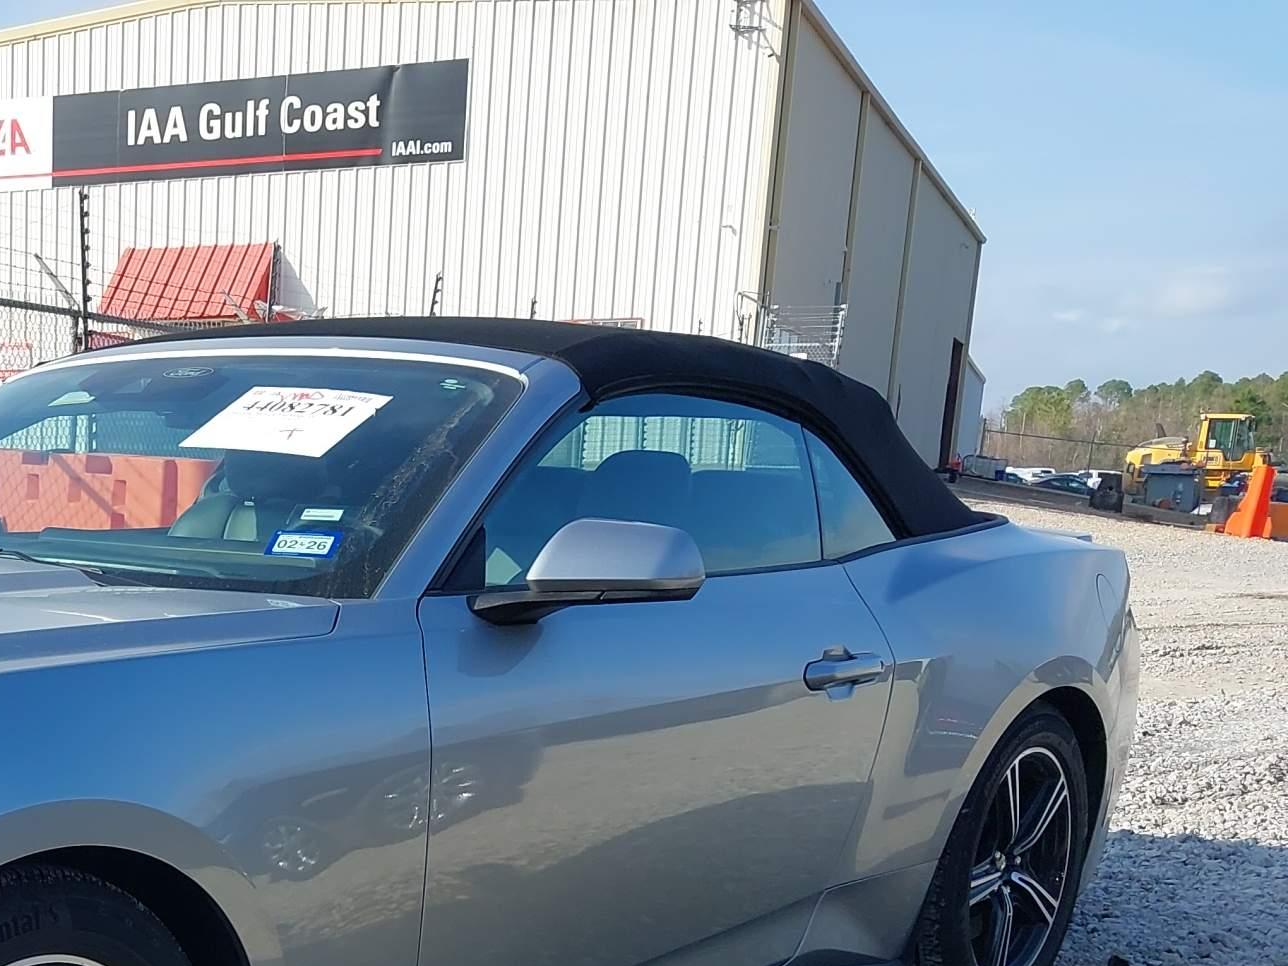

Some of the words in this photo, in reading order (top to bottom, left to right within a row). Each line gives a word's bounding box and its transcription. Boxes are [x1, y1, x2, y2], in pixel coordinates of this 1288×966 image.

[127, 106, 188, 146] IAA
[199, 98, 270, 140] Gulf
[280, 93, 382, 134] Coast
[391, 139, 453, 157] IAAI.com
